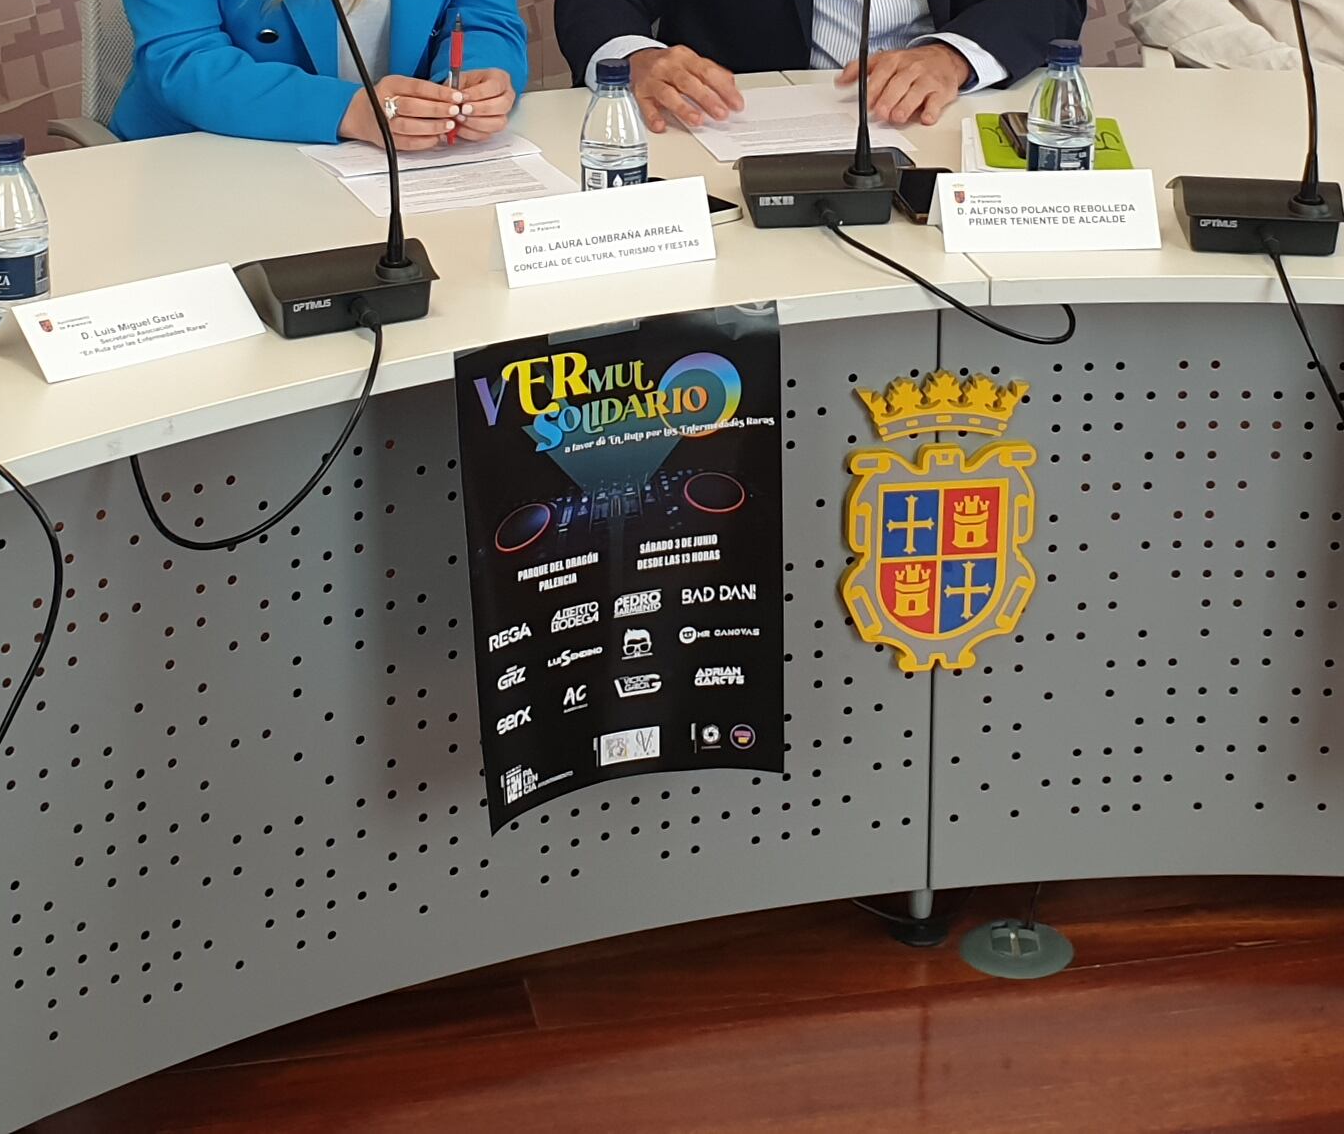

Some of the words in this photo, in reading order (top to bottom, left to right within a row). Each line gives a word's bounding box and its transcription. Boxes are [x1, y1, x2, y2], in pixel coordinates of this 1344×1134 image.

[956, 207, 967, 216] D.
[969, 206, 1018, 215] ALFONSO
[1021, 205, 1071, 214] POLANCO
[1074, 204, 1136, 213] REBOLLEDA
[968, 217, 1007, 226] PRIMER
[1011, 216, 1059, 225] TENIENTE
[1062, 216, 1075, 224] DE
[1078, 215, 1126, 224] ALCALDE
[548, 238, 583, 252] LAURA
[585, 229, 641, 246] LOMBRAÑA
[643, 224, 684, 238] ARREAL
[514, 258, 559, 272] CONCEJAL
[561, 257, 573, 266] DE
[574, 251, 616, 264] CULTURA,
[618, 245, 656, 258] TURISMO
[664, 239, 700, 251] FIESTAS
[81, 331, 93, 340] D.
[94, 327, 116, 337] Luis
[117, 318, 151, 332] Miguel
[533, 385, 709, 453] SOLIDARIO
[572, 440, 594, 453] favor
[646, 428, 662, 439] por
[746, 416, 775, 426] Raras
[639, 539, 674, 554] SÁBADO
[674, 538, 680, 549] 3
[681, 537, 692, 548] DE
[693, 534, 718, 547] JUNIO
[517, 564, 549, 582] PARQUE
[549, 560, 564, 575] DEL
[565, 551, 599, 571] DRAGÓN
[637, 557, 663, 570] DESDE
[664, 554, 680, 566] LAS
[681, 553, 691, 565] 13
[691, 549, 721, 563] HORAS
[538, 572, 577, 592] PALENCIA
[614, 590, 662, 610] PEDRO
[681, 585, 715, 605] BAD
[719, 583, 757, 602] DANI
[550, 611, 599, 633] BODEGA
[488, 623, 532, 652] REGA
[497, 666, 526, 691] GRZ
[695, 666, 742, 677] ADRIAN
[563, 684, 587, 706] AC
[522, 773, 539, 786] LEN
[522, 782, 537, 795] CIA
